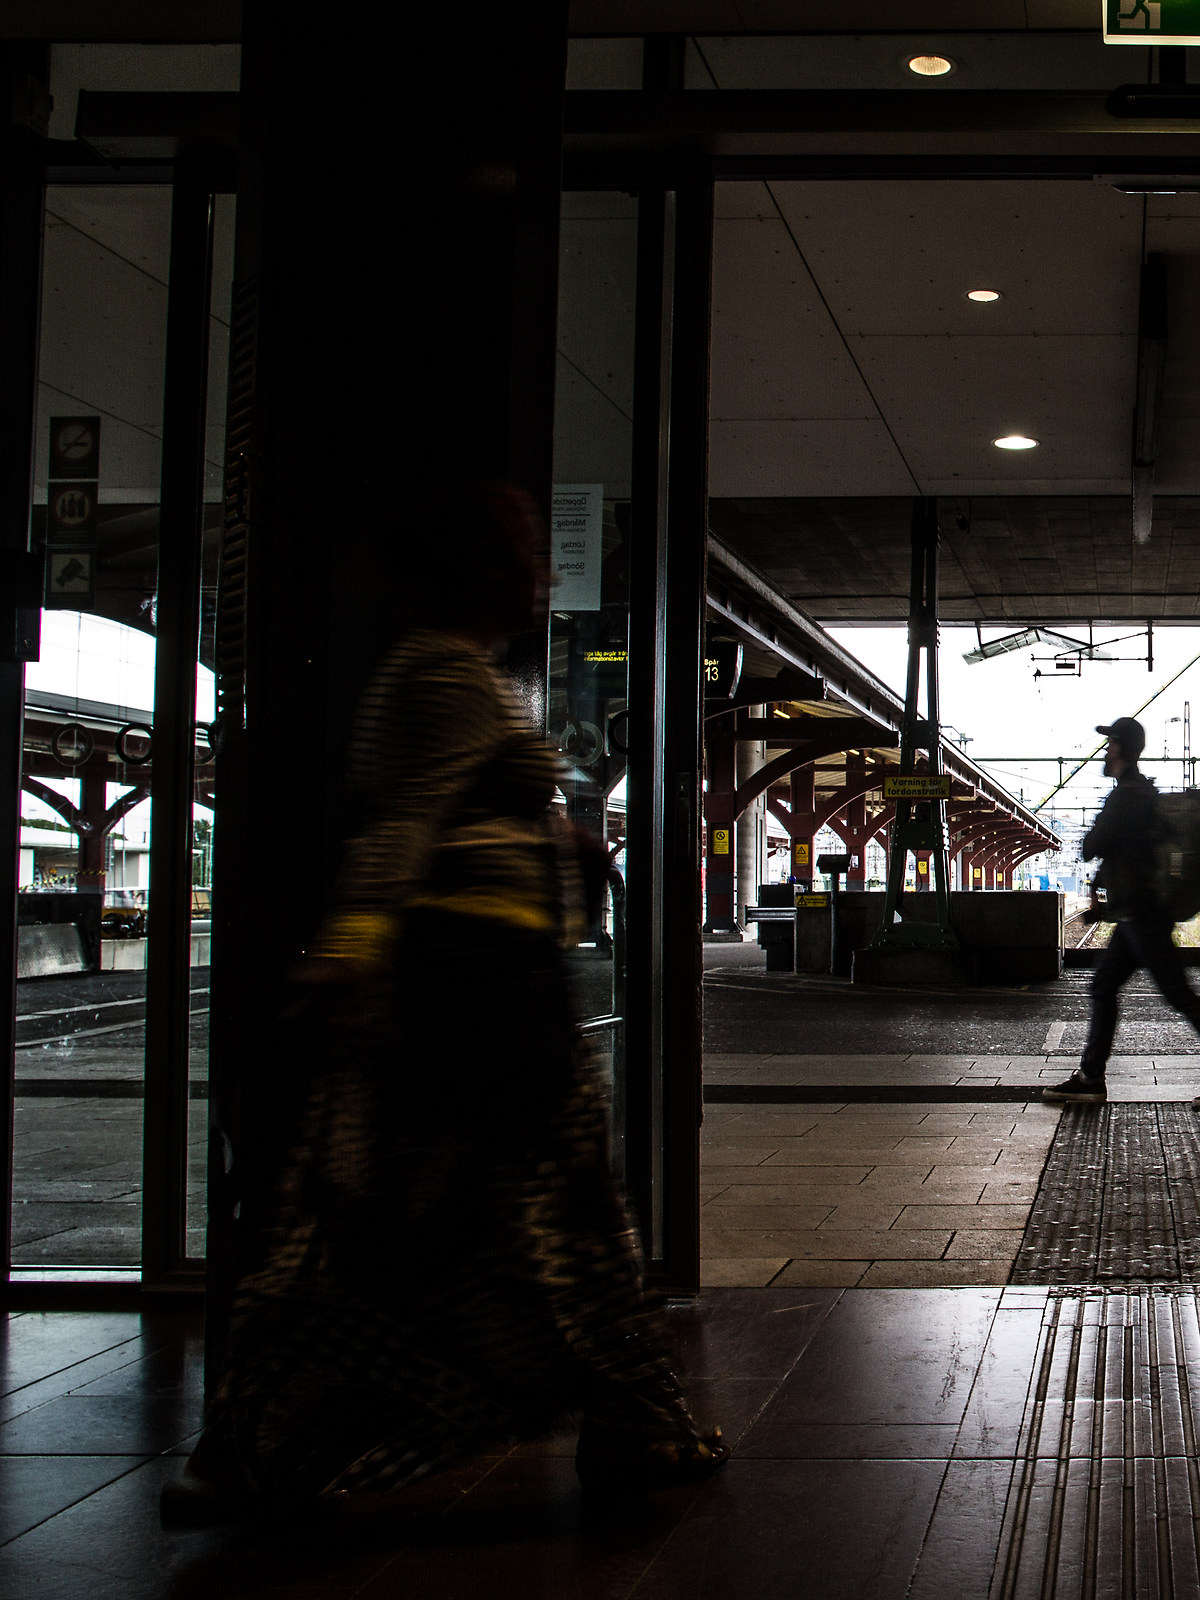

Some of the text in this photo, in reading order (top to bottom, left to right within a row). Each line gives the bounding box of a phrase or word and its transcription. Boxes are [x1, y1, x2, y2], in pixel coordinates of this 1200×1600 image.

[705, 666, 719, 682] 13
[892, 778, 942, 787] Varning för
[888, 788, 946, 796] fordonstrafik
